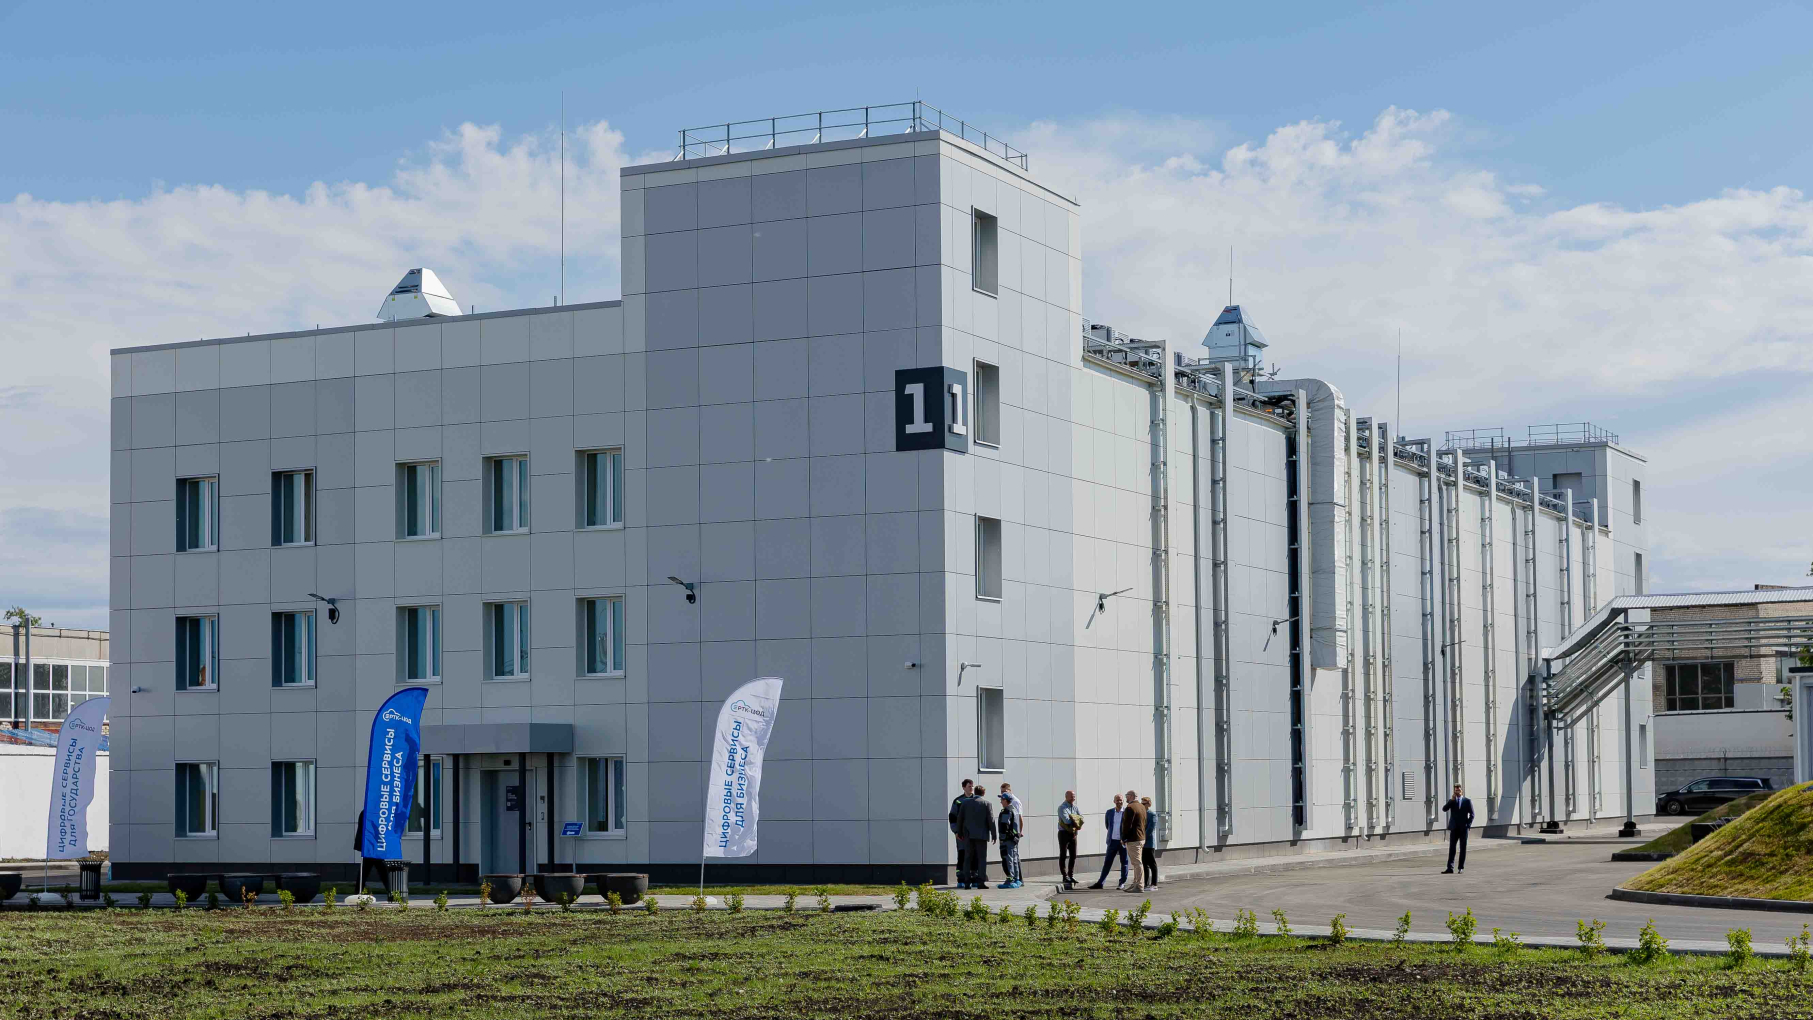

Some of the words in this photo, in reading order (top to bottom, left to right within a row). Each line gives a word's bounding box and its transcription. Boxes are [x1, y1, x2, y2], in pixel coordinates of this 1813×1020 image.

[904, 383, 933, 434] 1
[948, 383, 967, 436] 1
[62, 738, 78, 788] СЕРВИСЫ
[382, 728, 395, 781] СЕРВИСЫ
[725, 720, 742, 776] СЕРВИСЫ
[736, 745, 749, 799] БИЗНЕСА
[67, 746, 85, 821] ГОСУДАРСТВА
[393, 752, 403, 803] БИЗНЕСА
[377, 784, 390, 851] ЦИФРОВЫЕ
[719, 780, 733, 848] ЦИФРОВЫЕ
[735, 802, 745, 828] ДЛЯ
